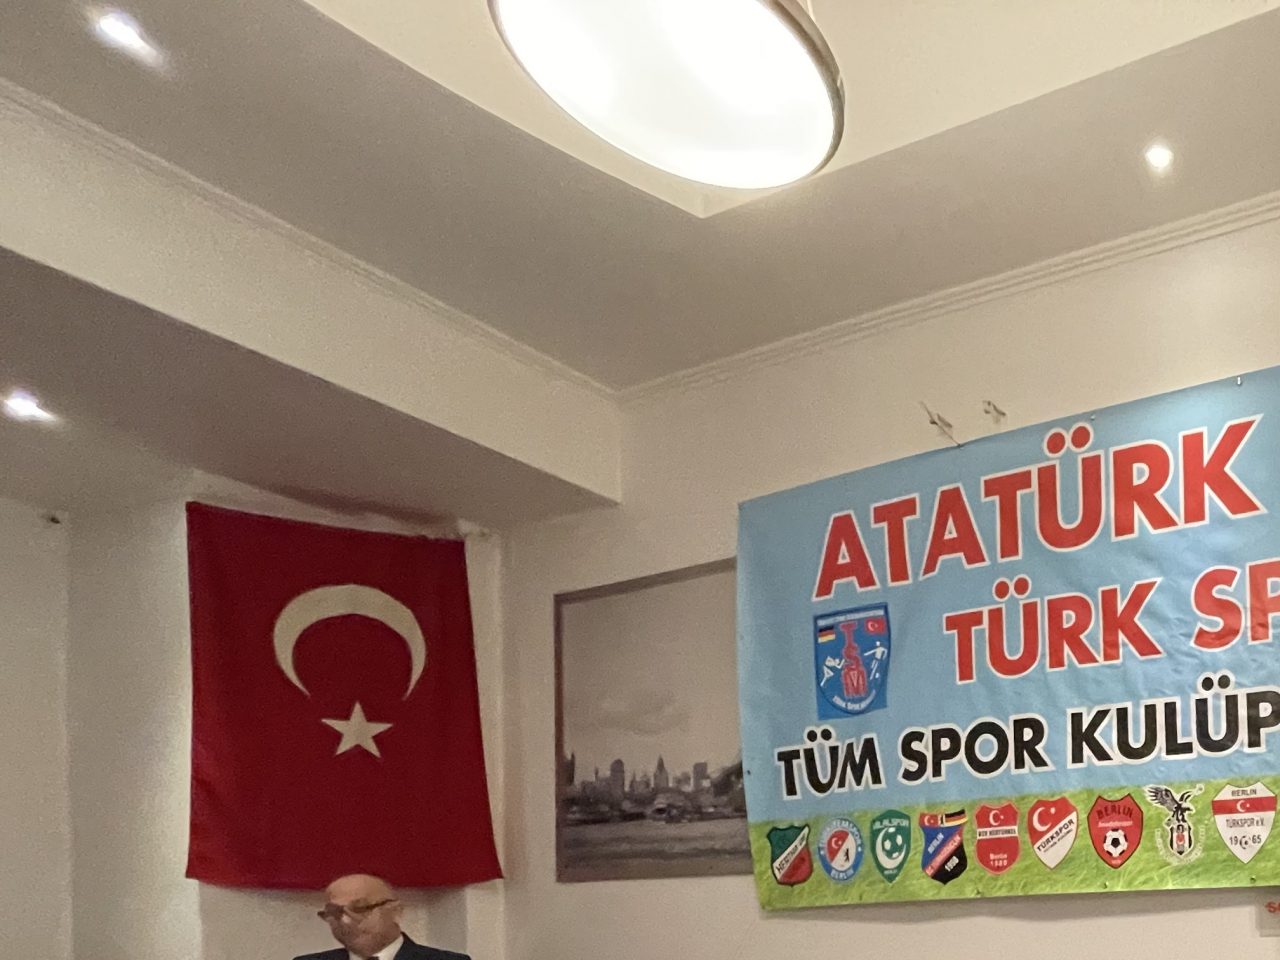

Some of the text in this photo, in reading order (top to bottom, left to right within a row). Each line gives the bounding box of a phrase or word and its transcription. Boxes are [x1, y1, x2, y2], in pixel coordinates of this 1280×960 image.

[814, 416, 1264, 600] ATATÜRK
[945, 576, 1163, 684] TÜRK
[777, 729, 883, 797] TÜM
[900, 717, 1048, 783] SPOR
[1096, 804, 1134, 820] BERLIN
[1231, 788, 1258, 797] BERLIN
[1036, 818, 1076, 852] TÜRKSPOR
